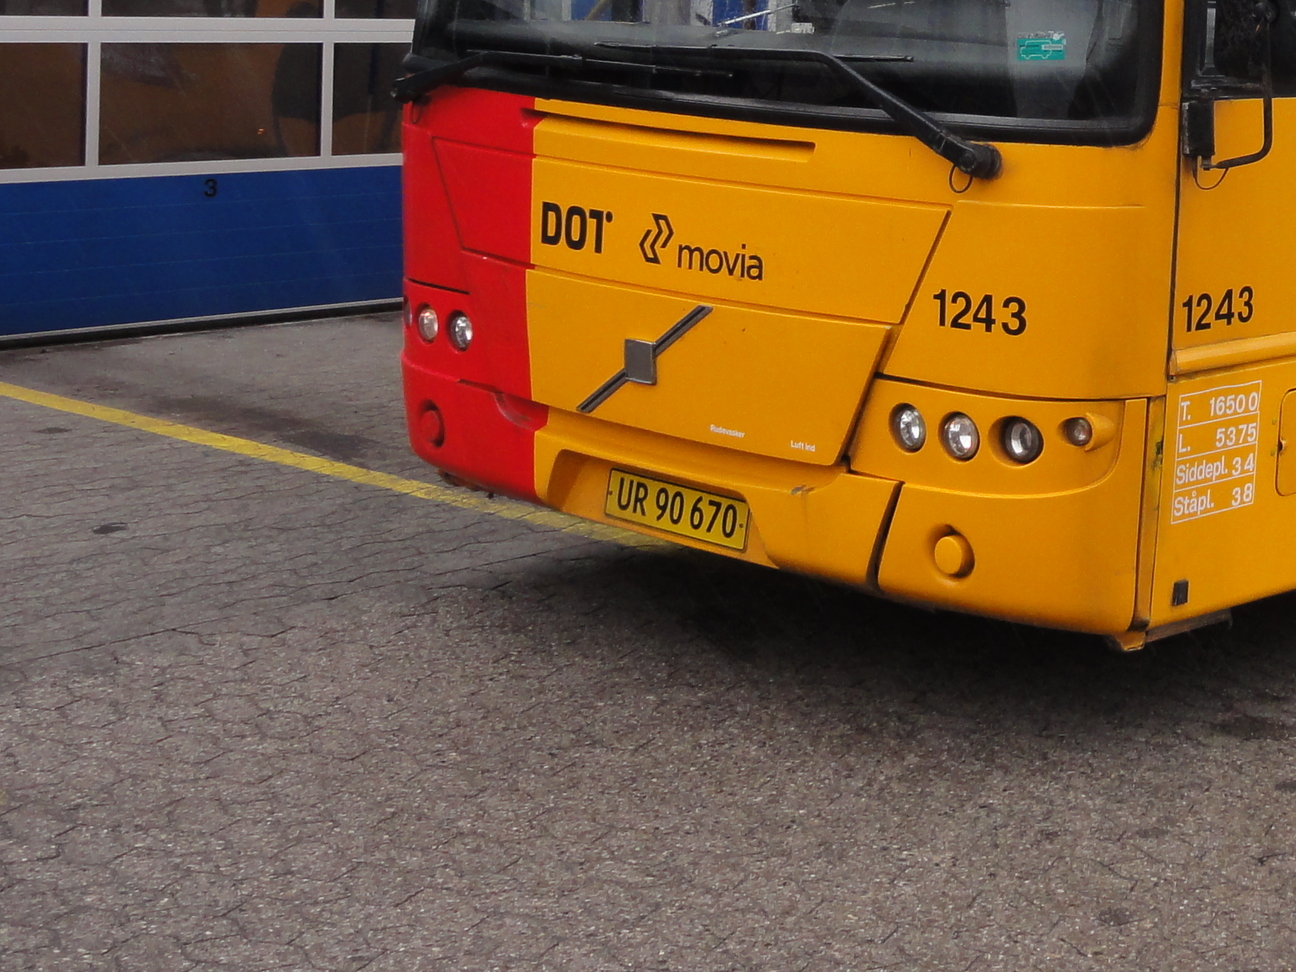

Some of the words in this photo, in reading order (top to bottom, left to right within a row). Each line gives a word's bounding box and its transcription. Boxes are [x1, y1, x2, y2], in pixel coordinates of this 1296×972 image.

[203, 178, 218, 197] 3
[540, 200, 613, 254] DOT
[676, 242, 764, 281] movia
[932, 288, 1027, 336] 1243
[1182, 285, 1254, 333] 1243
[1180, 400, 1191, 421] T.
[1209, 392, 1258, 416] 16500
[790, 440, 805, 451] Luft
[1178, 433, 1191, 453] L.
[1215, 423, 1257, 448] 5375
[1176, 455, 1228, 485] Siddepl.
[1232, 453, 1254, 476] 34
[616, 476, 650, 517] UR
[655, 486, 685, 525] 90
[689, 495, 738, 539] 670
[1173, 489, 1215, 516] Ståpl.
[1231, 483, 1253, 507] 38
